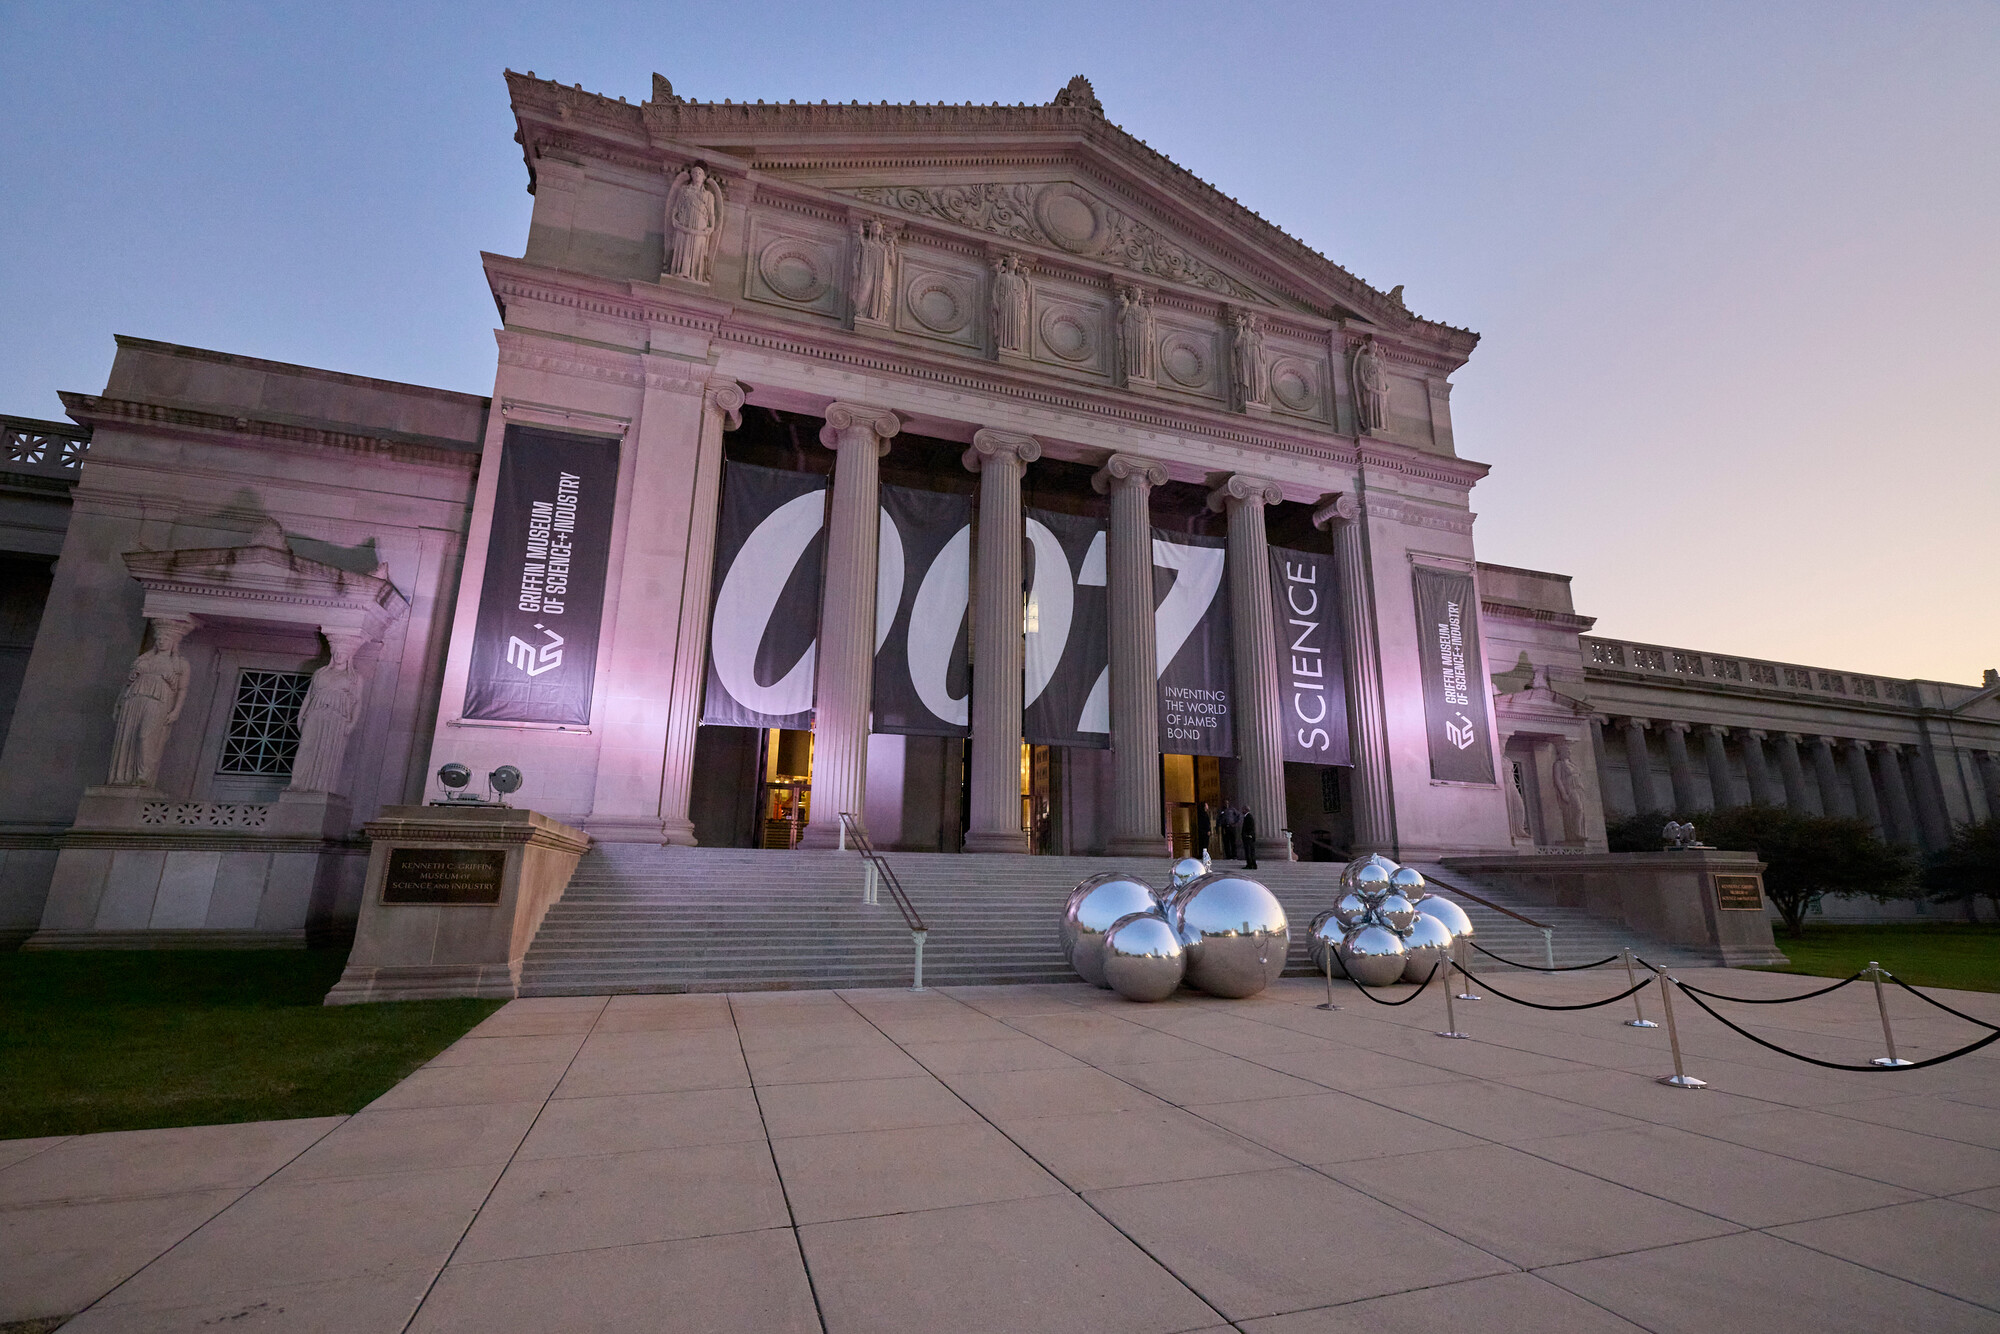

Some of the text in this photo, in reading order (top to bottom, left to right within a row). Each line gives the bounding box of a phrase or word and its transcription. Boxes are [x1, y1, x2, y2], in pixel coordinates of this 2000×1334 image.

[519, 501, 553, 613] GRIFFIN MUSEUM
[543, 596, 565, 615] OF
[712, 489, 1225, 732] 007
[1286, 561, 1330, 751] SCIENCE
[1438, 623, 1457, 704] GRIFFIN MUSEUM
[1165, 686, 1226, 701] INVENTING
[1456, 691, 1468, 705] OF
[1165, 700, 1227, 715] THE WORLD
[1166, 713, 1218, 728] OF JAMES
[1167, 728, 1200, 740] BOND
[401, 862, 445, 870] KENNETH
[457, 862, 493, 870] GRIFFIN
[420, 872, 459, 880] MUSEUM
[451, 882, 495, 890] INDUSTRY
